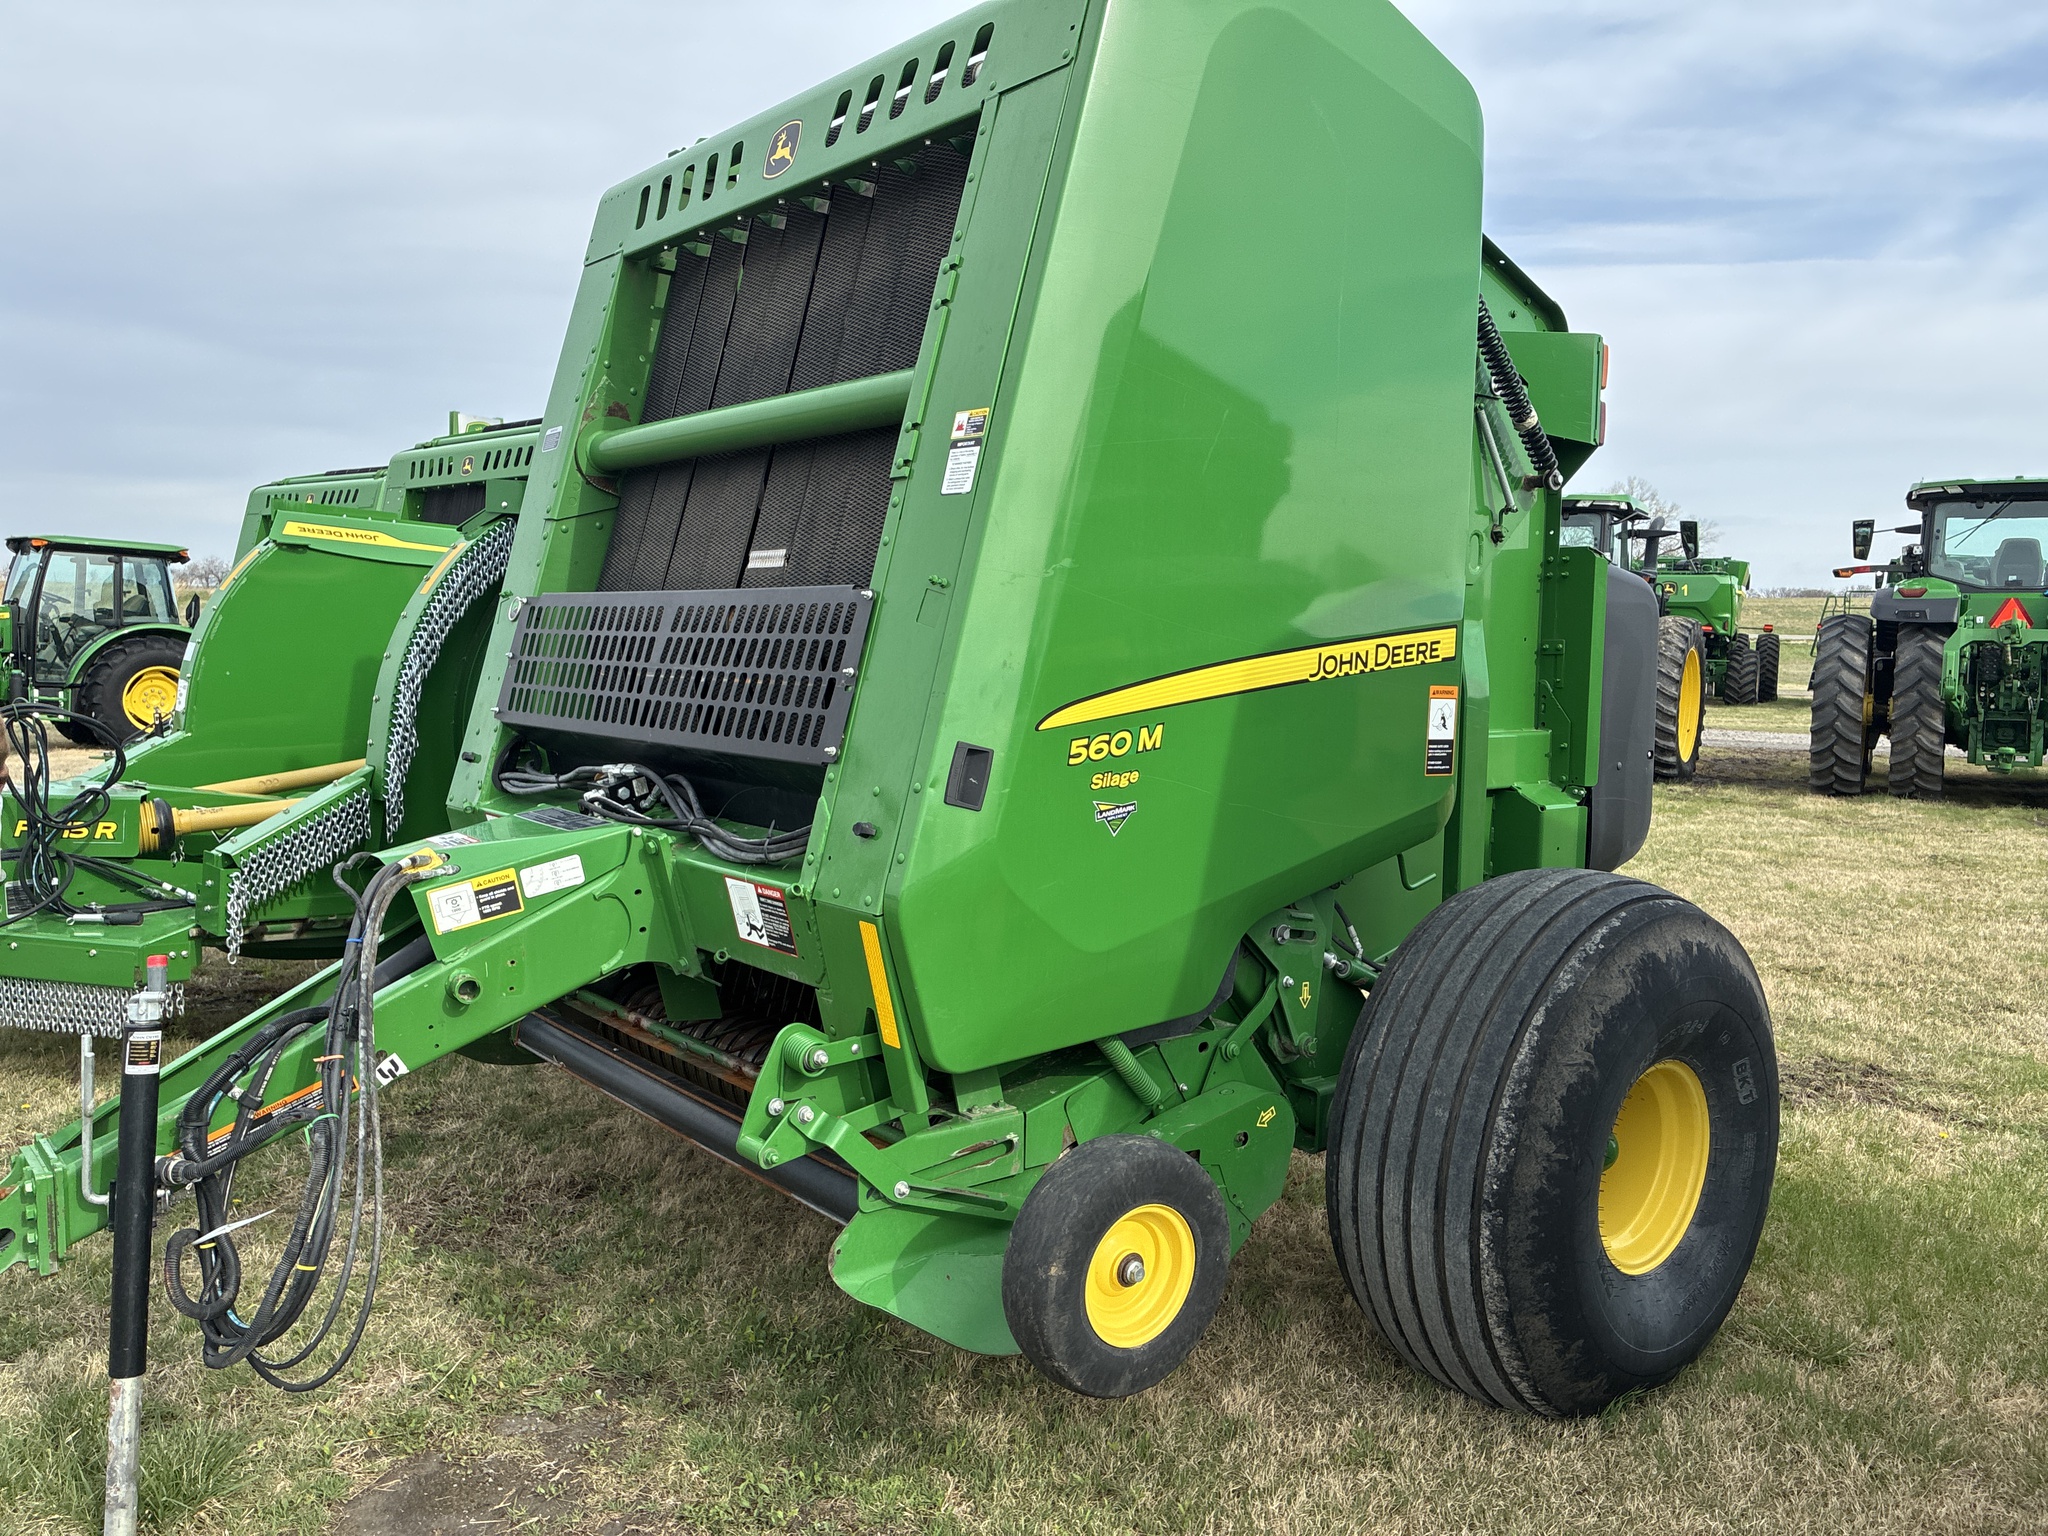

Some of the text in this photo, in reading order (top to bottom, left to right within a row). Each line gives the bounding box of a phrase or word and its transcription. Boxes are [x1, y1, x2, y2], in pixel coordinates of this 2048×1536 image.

[298, 526, 380, 541] JOHN DEERE
[1681, 584, 1688, 597] 1
[1308, 640, 1441, 678] JOHN DEERE
[1067, 722, 1165, 766] 560 M
[1090, 769, 1140, 791] Silage
[93, 820, 118, 840] R
[482, 874, 511, 886] CAUTION
[761, 887, 782, 899] DANGER
[1731, 1057, 1759, 1105] BKT
[254, 1099, 288, 1118] WARNING
